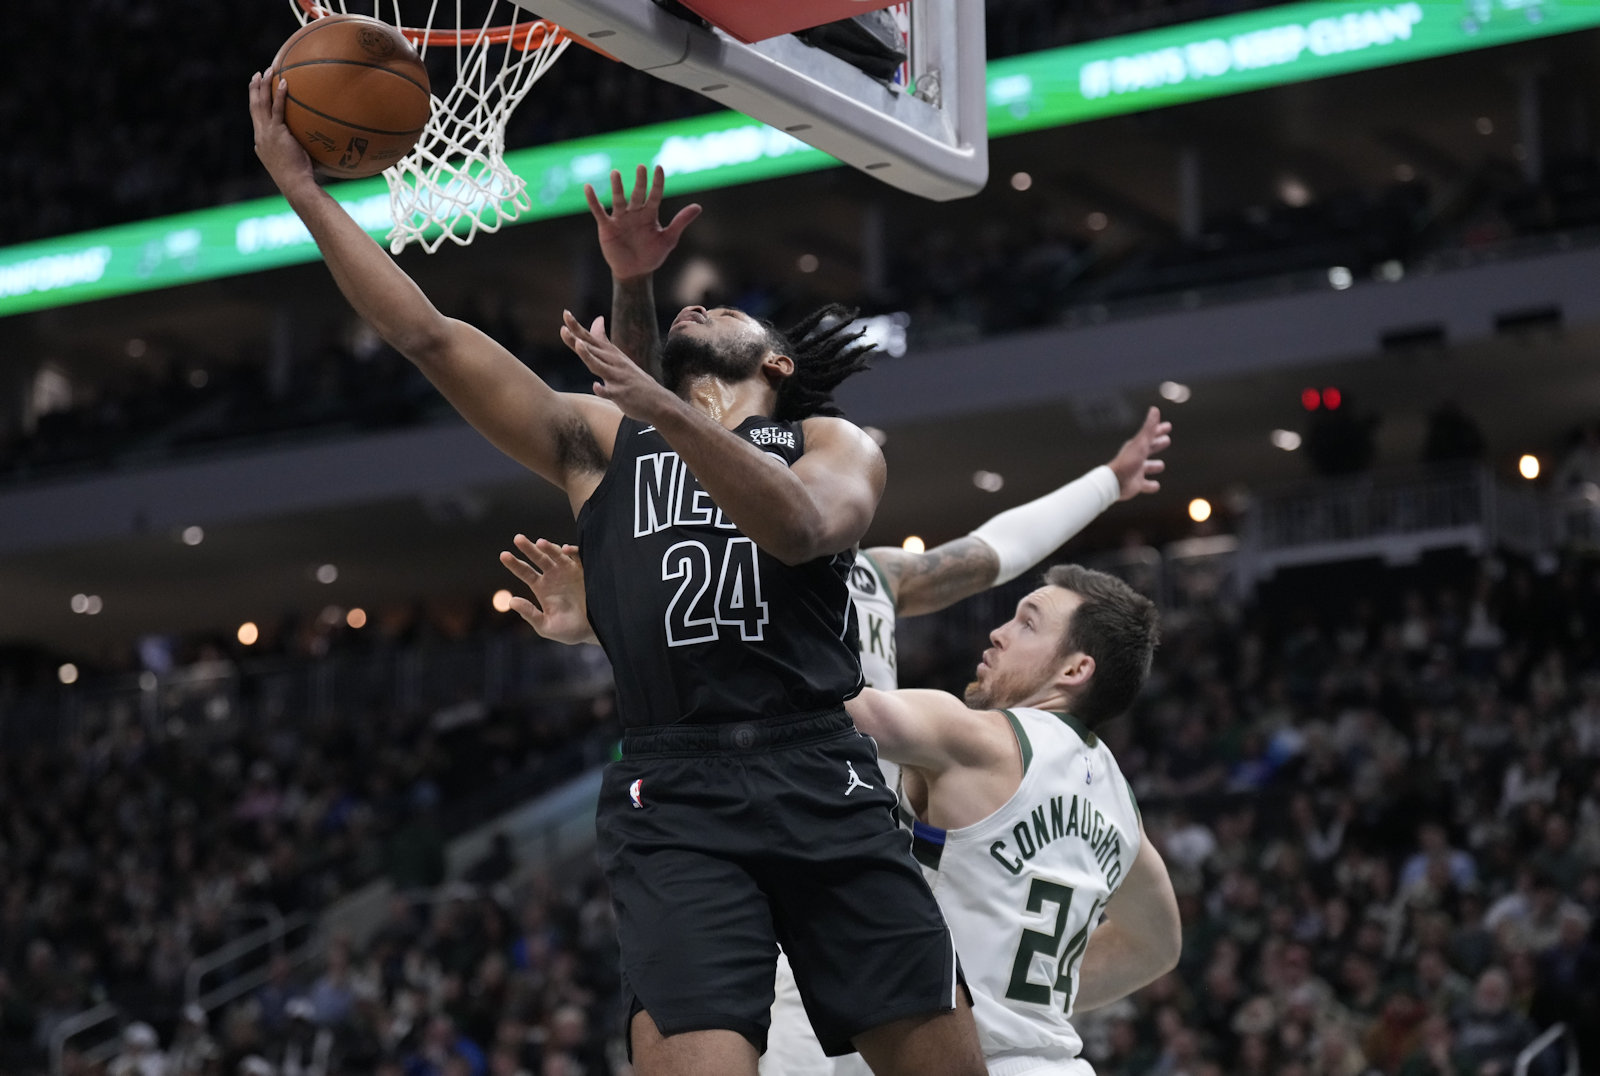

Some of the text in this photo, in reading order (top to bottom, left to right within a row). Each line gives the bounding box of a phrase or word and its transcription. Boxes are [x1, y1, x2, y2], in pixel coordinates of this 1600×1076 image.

[750, 426, 778, 435] GET
[750, 432, 793, 440] YOUR
[634, 452, 738, 538] NE
[662, 537, 769, 647] 24
[990, 794, 1121, 908] CONNAUGHTO
[1005, 877, 1100, 1014] 24
